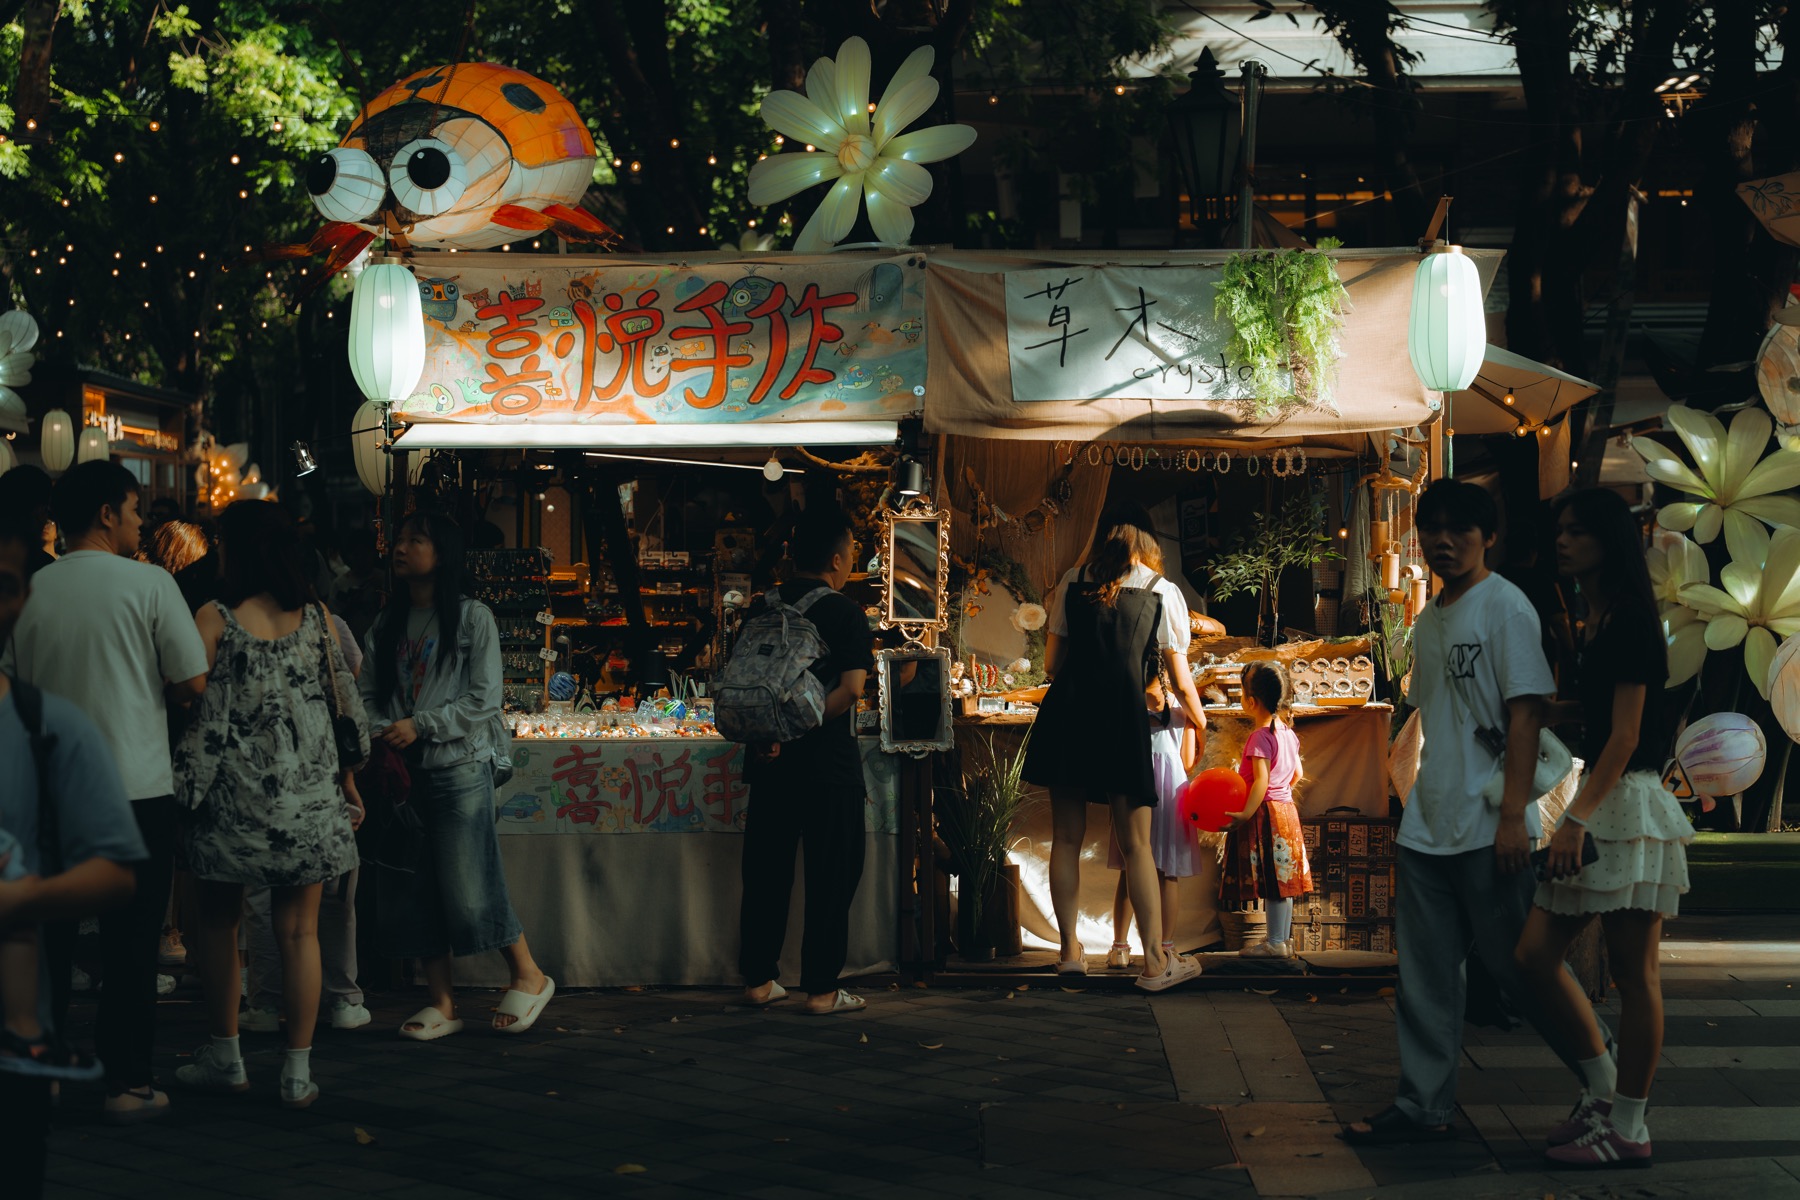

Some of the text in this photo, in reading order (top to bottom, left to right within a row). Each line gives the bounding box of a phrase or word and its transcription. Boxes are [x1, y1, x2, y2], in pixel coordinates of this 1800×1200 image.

[475, 280, 859, 416] 喜悦手作
[1023, 277, 1198, 368] 草木
